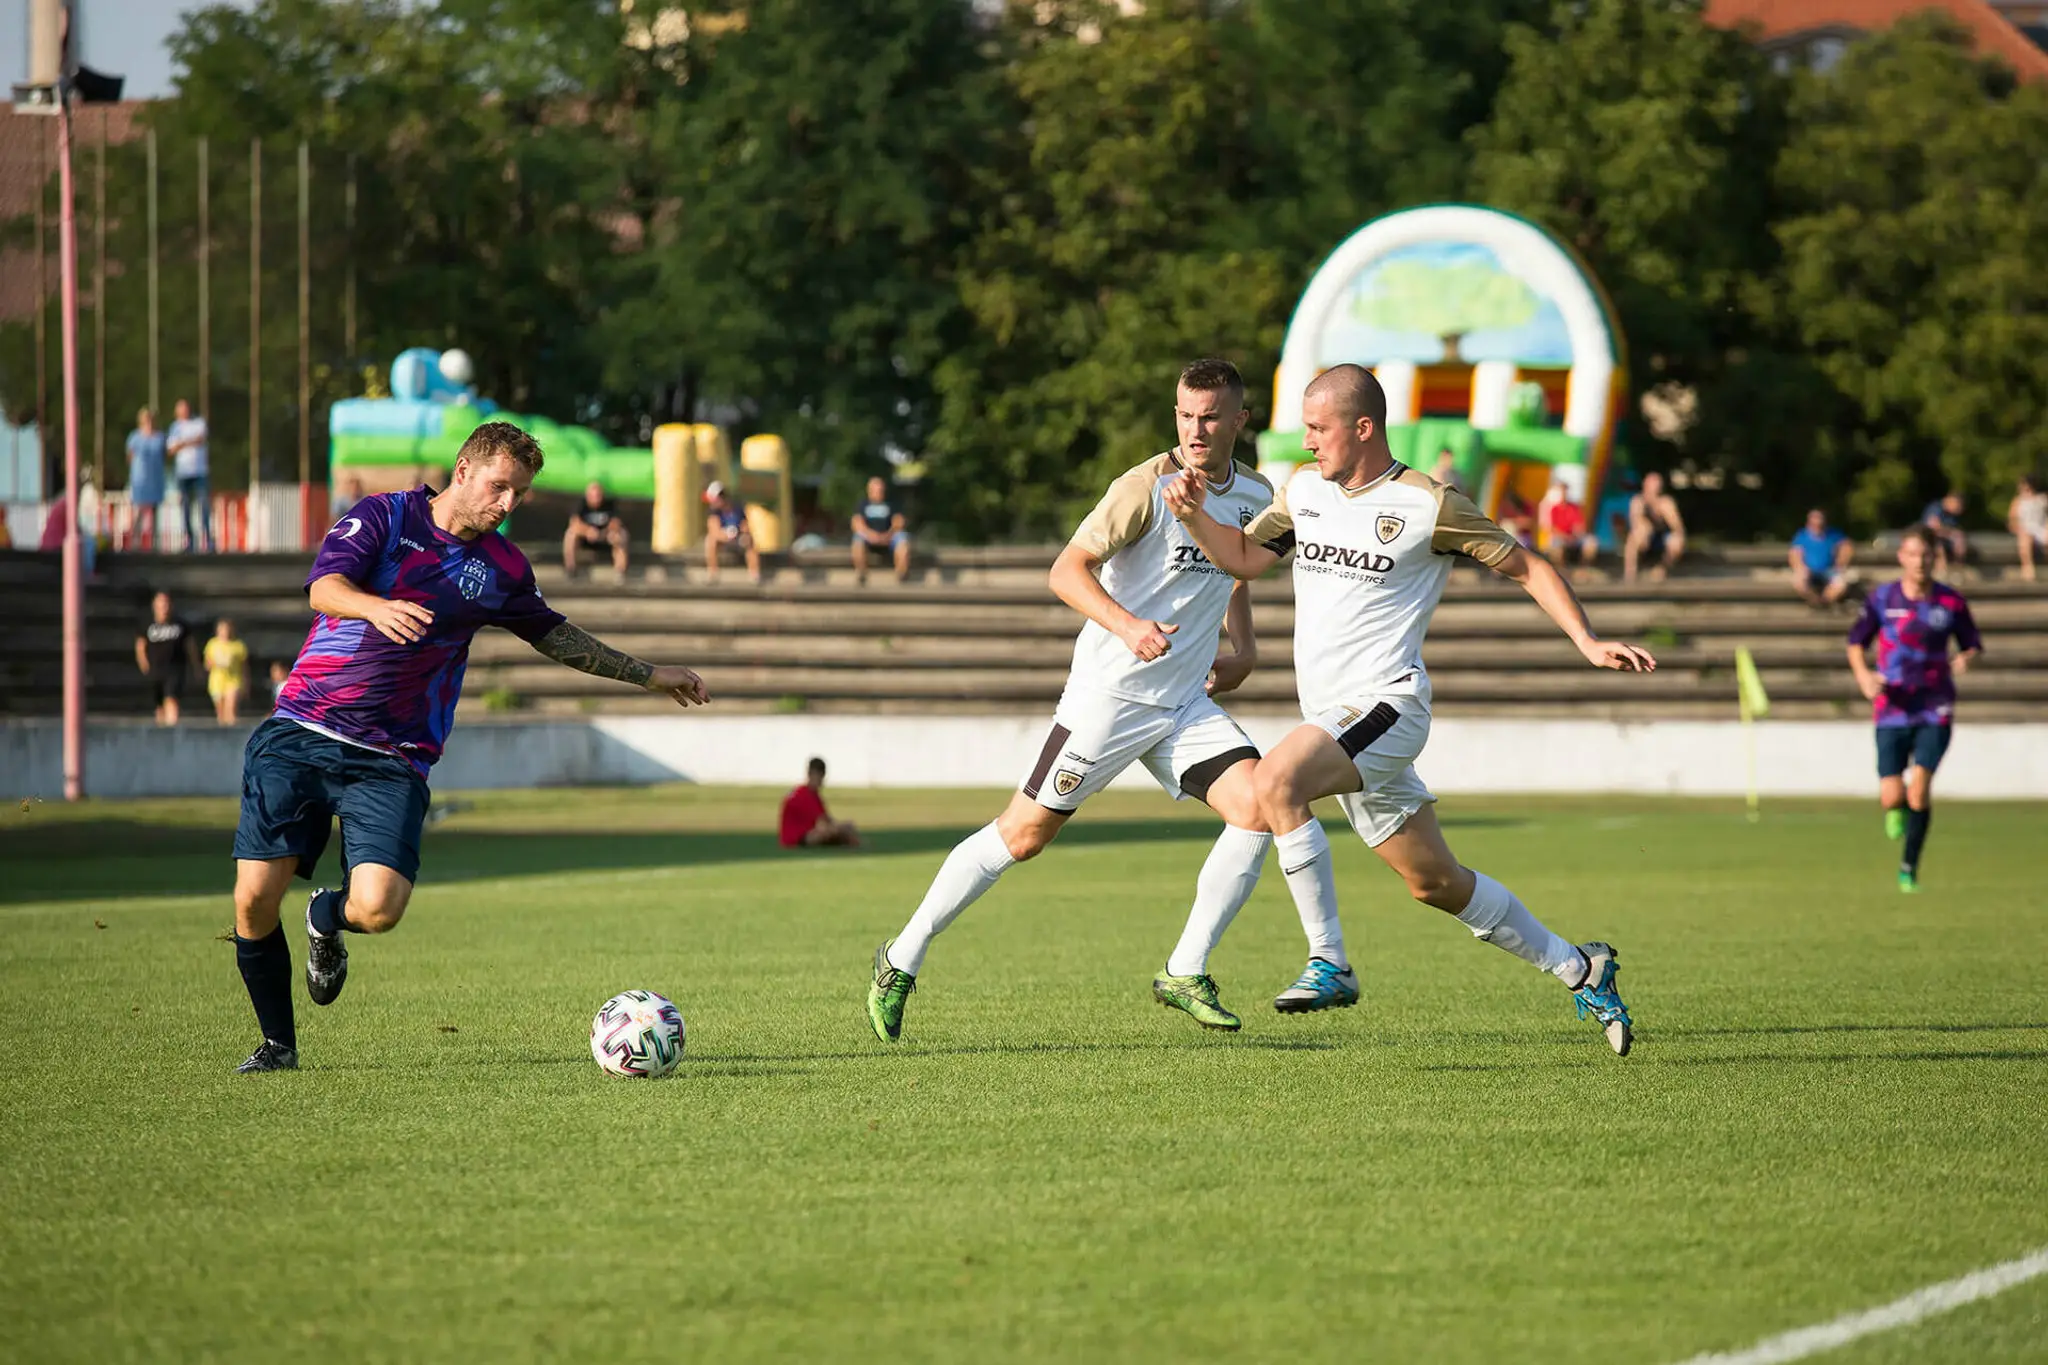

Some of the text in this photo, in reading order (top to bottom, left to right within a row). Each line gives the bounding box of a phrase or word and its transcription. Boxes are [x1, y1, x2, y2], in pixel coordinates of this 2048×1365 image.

[1174, 546, 1211, 563] TO
[1296, 562, 1387, 585] ANSPORT LOGISTICS
